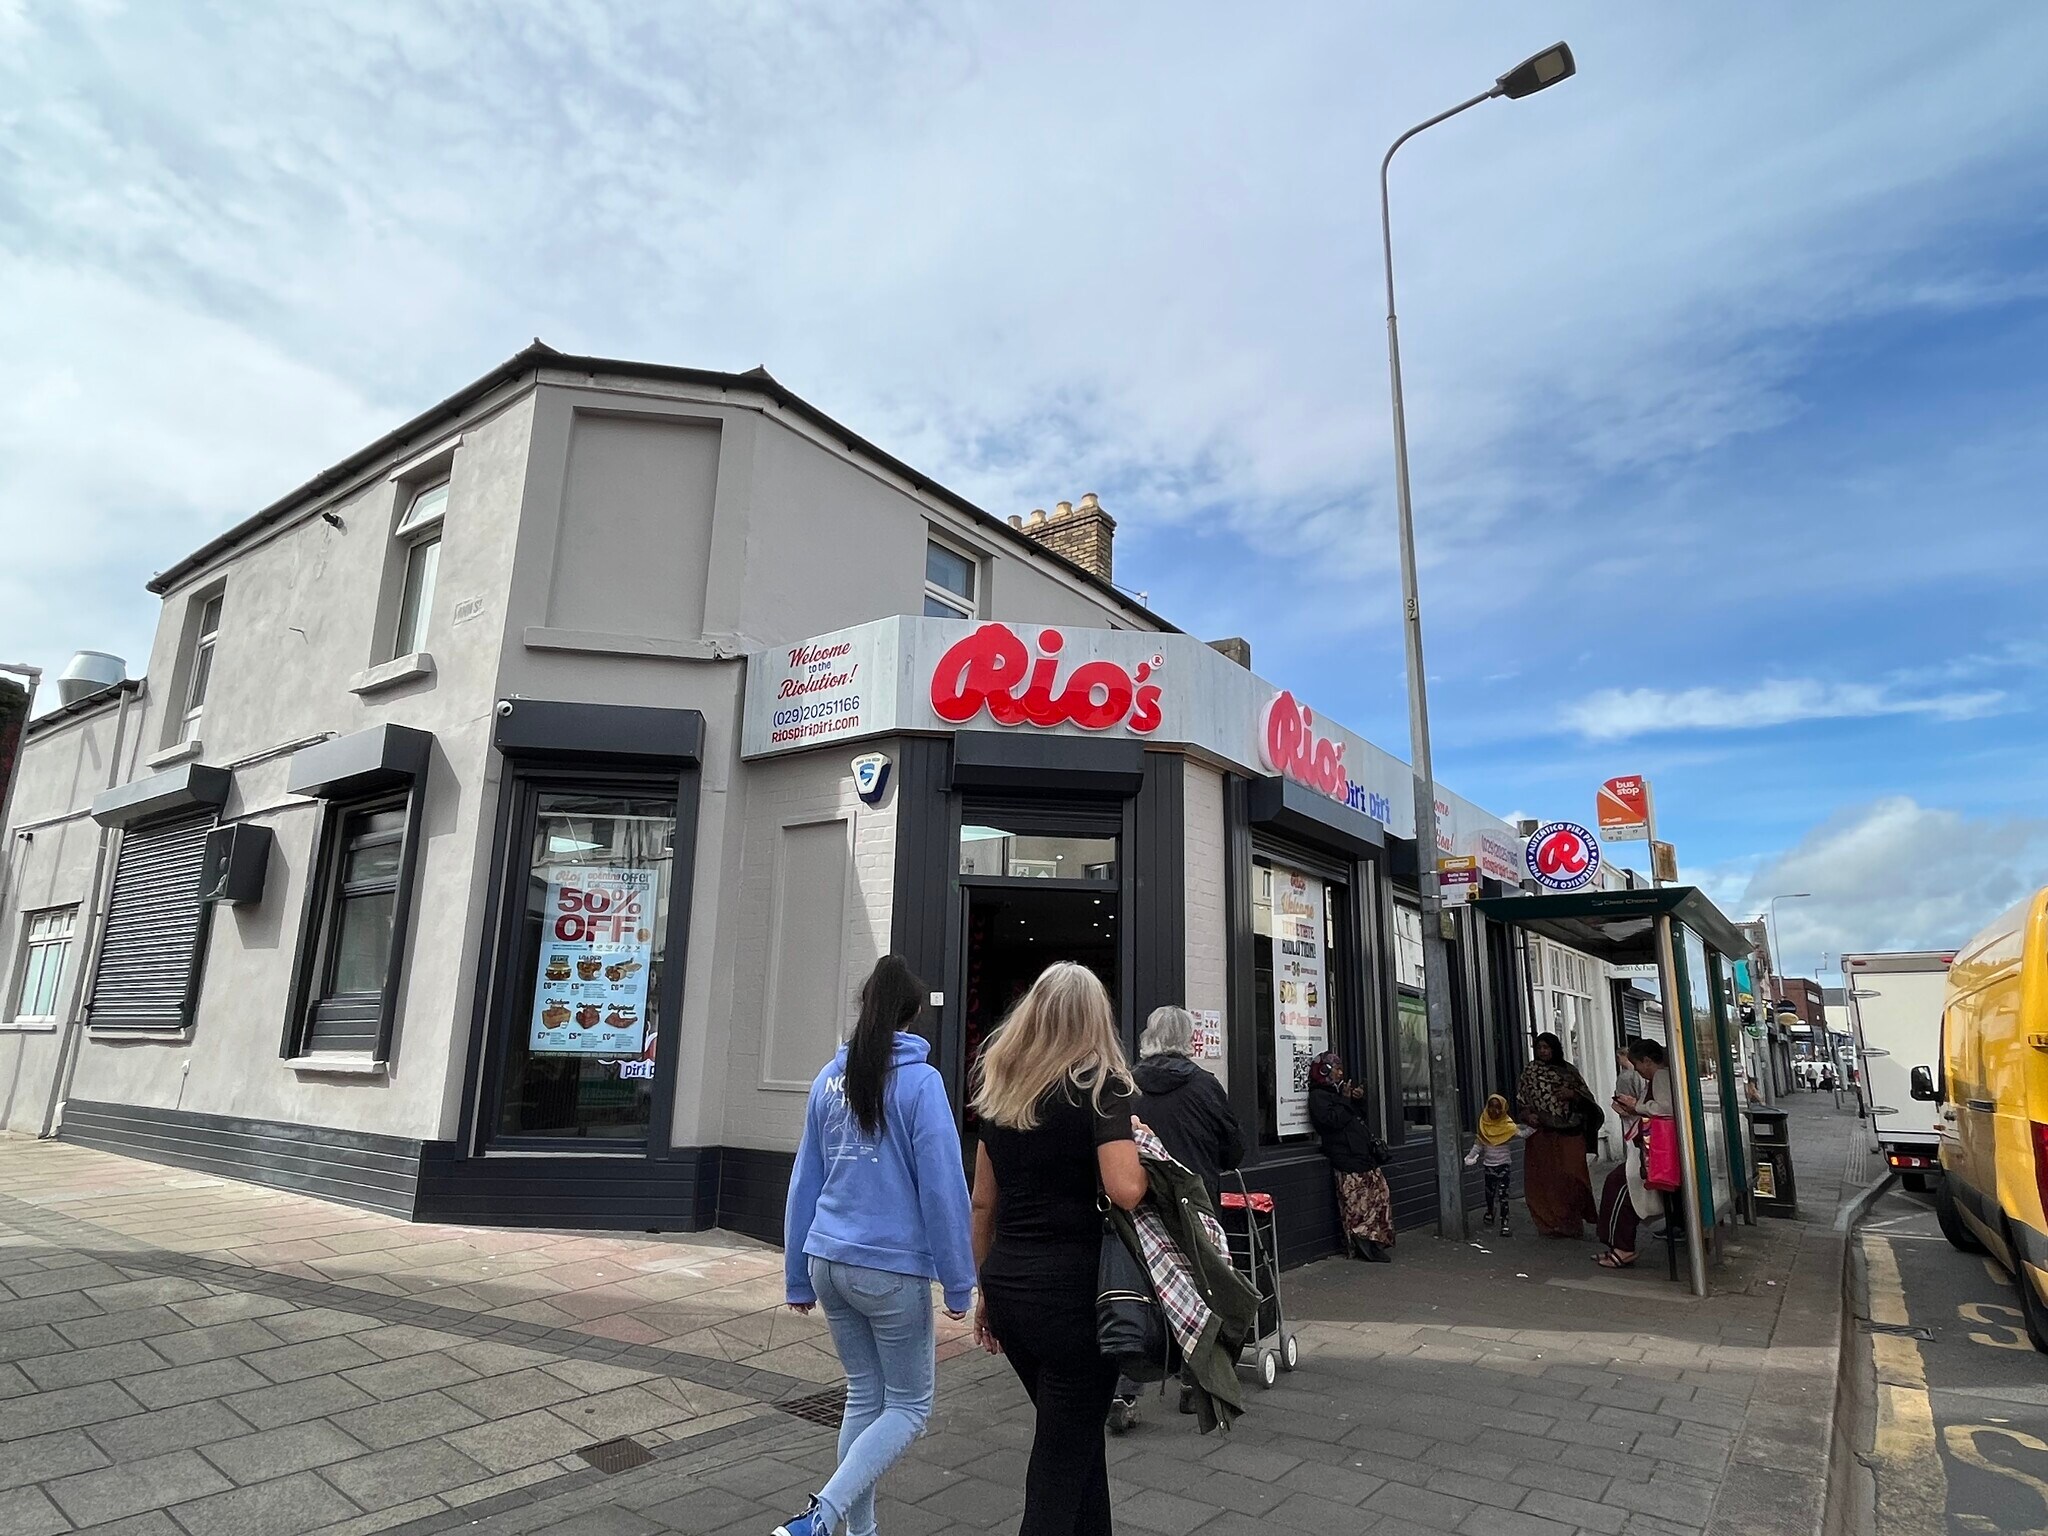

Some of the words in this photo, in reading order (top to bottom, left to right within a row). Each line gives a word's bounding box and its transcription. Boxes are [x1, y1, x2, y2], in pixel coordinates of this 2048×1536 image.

[788, 643, 851, 668] Welcome
[809, 665, 817, 674] to
[818, 661, 831, 672] the
[777, 664, 858, 700] Riolution!
[930, 623, 1163, 735] Rio's
[773, 695, 860, 728] (029)20251166
[1264, 690, 1348, 804] Rio's
[1615, 780, 1635, 788] bus
[1616, 787, 1640, 796] stop
[1369, 792, 1391, 824] piri
[1528, 824, 1564, 855] AUTENTICO
[1566, 824, 1585, 836] PIRI
[1583, 833, 1597, 851] PIRI
[1528, 861, 1541, 878] PIRI
[1540, 876, 1558, 888] PIRI
[558, 887, 642, 914] 50%
[555, 914, 638, 942] OFF
[625, 1064, 647, 1078] piri
